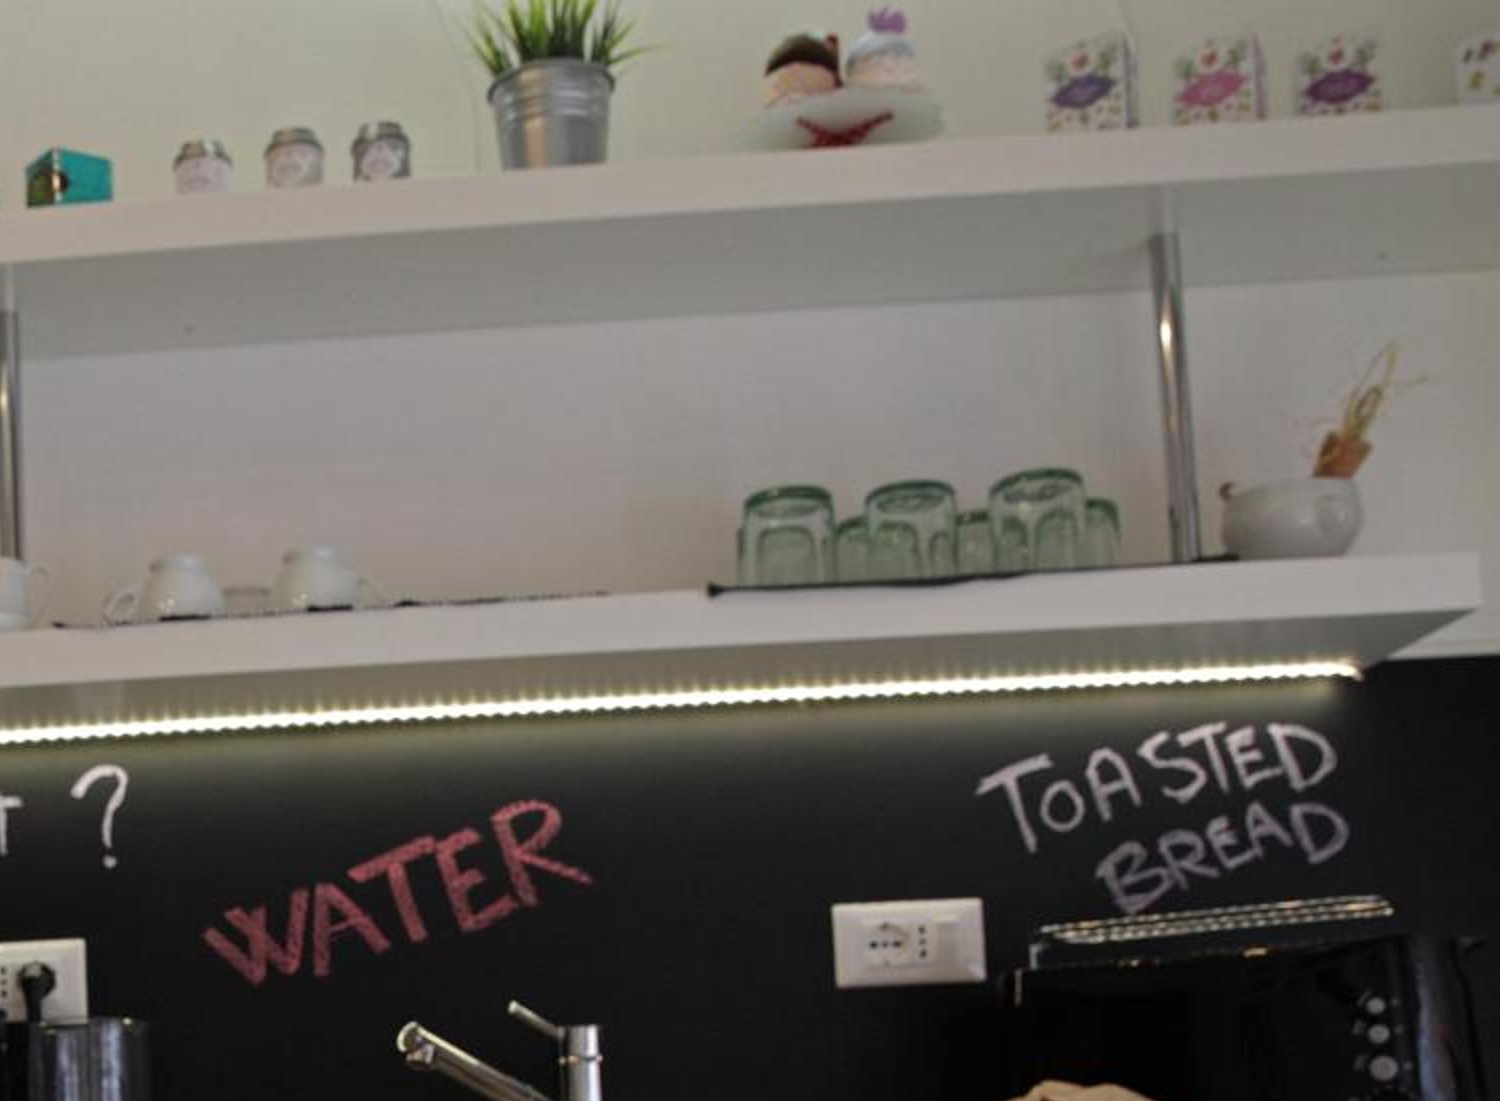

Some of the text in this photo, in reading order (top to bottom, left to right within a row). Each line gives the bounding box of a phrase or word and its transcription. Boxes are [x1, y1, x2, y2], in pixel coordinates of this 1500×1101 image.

[974, 721, 1339, 854] TOASTED
[202, 798, 594, 986] WATER
[1094, 801, 1351, 915] BREAD
